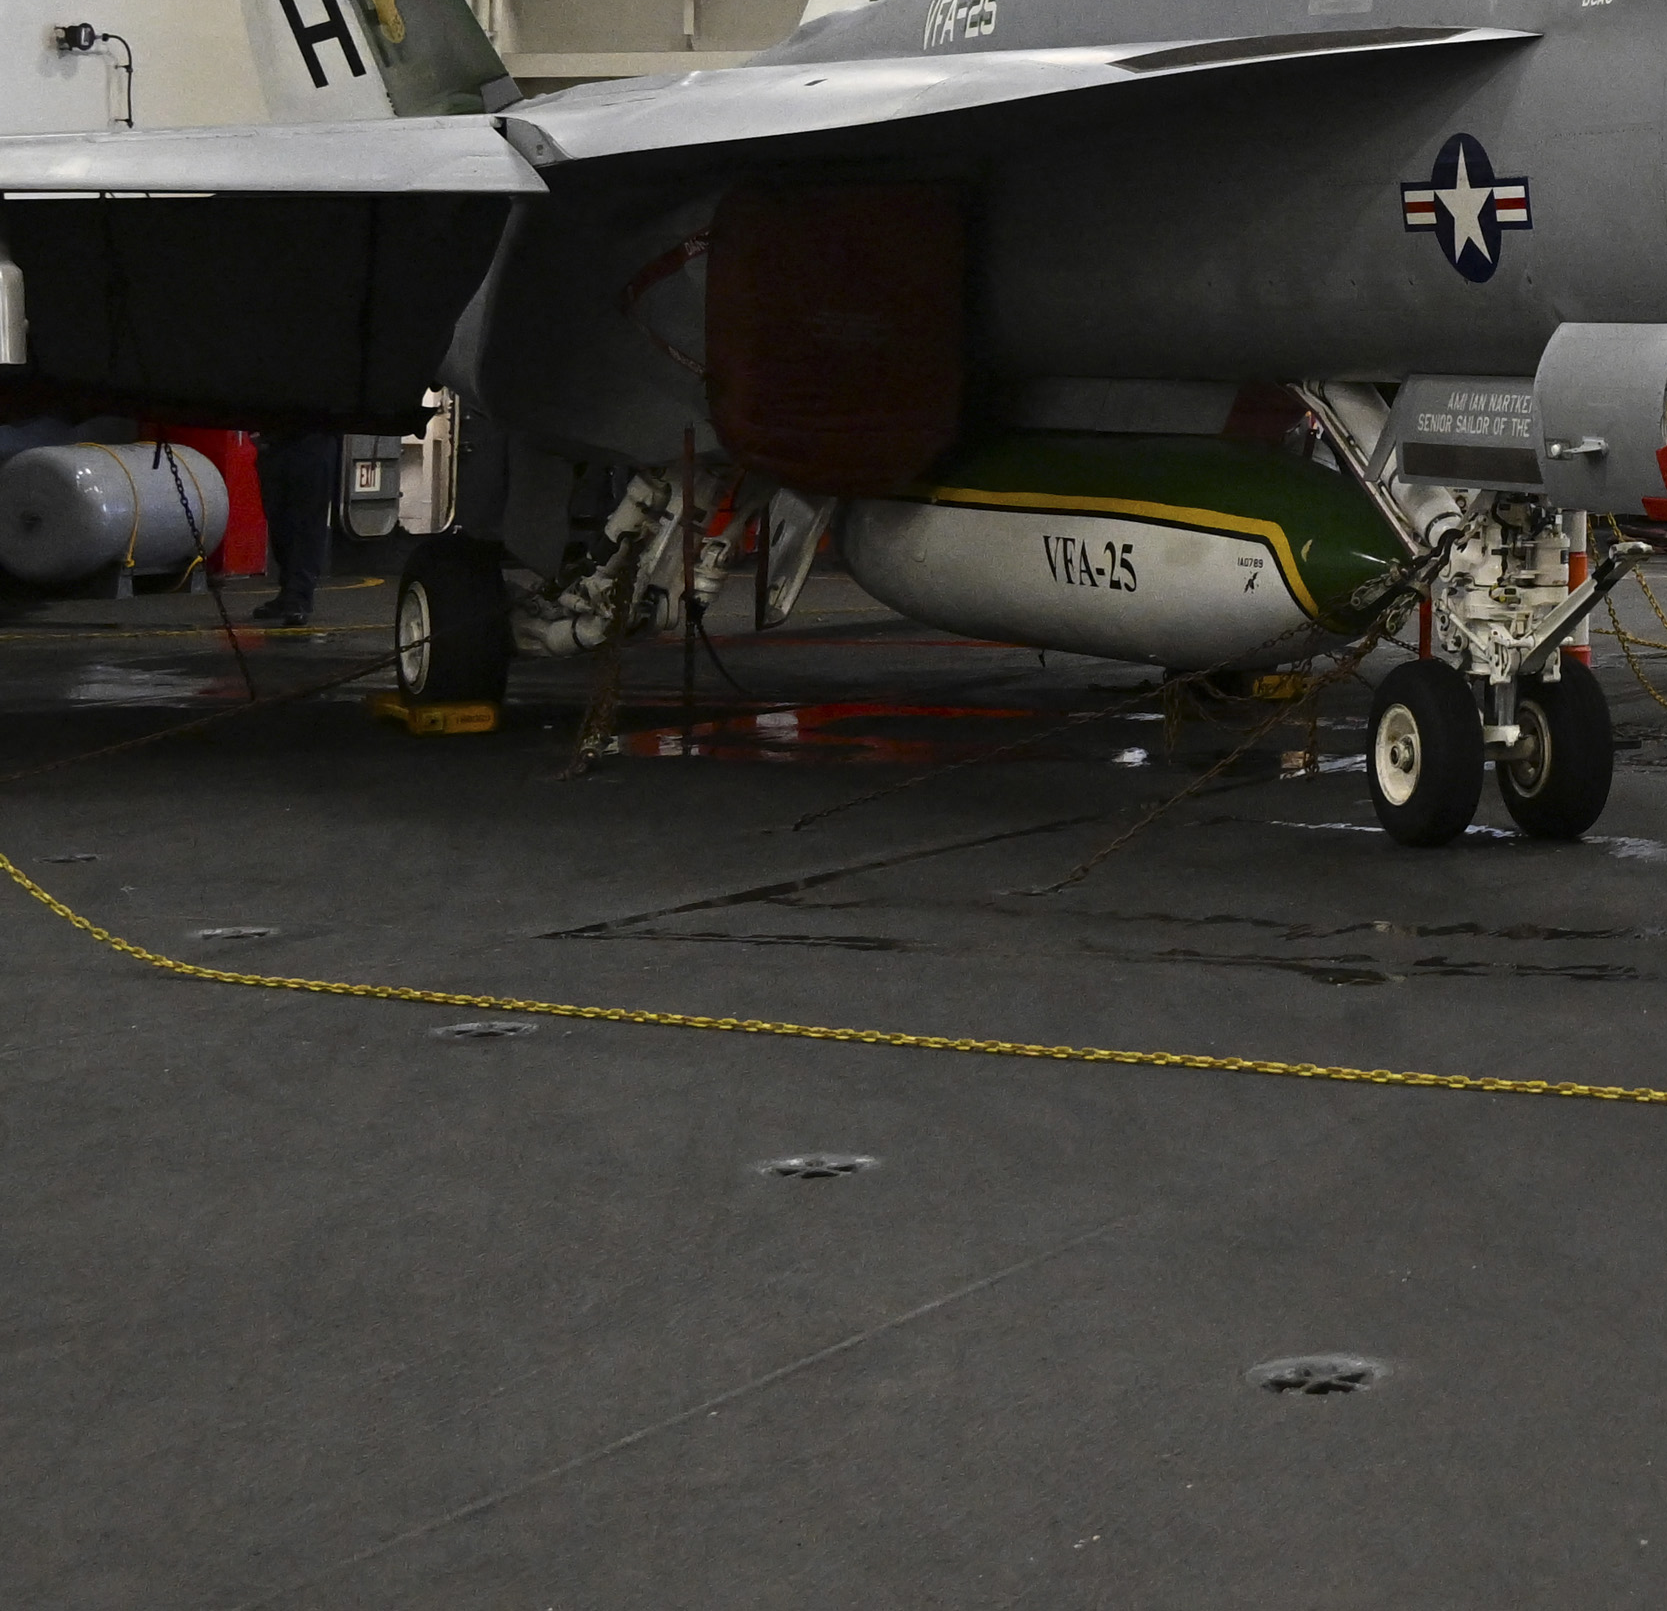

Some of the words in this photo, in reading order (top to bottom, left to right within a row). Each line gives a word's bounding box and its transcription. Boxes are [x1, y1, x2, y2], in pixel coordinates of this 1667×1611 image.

[1468, 393, 1488, 412] IAN
[1417, 413, 1452, 433] SENIOR
[1455, 415, 1490, 435] SAILOR
[1493, 417, 1508, 436] OF
[1511, 418, 1532, 438] THE
[1042, 535, 1138, 593] VFA-25
